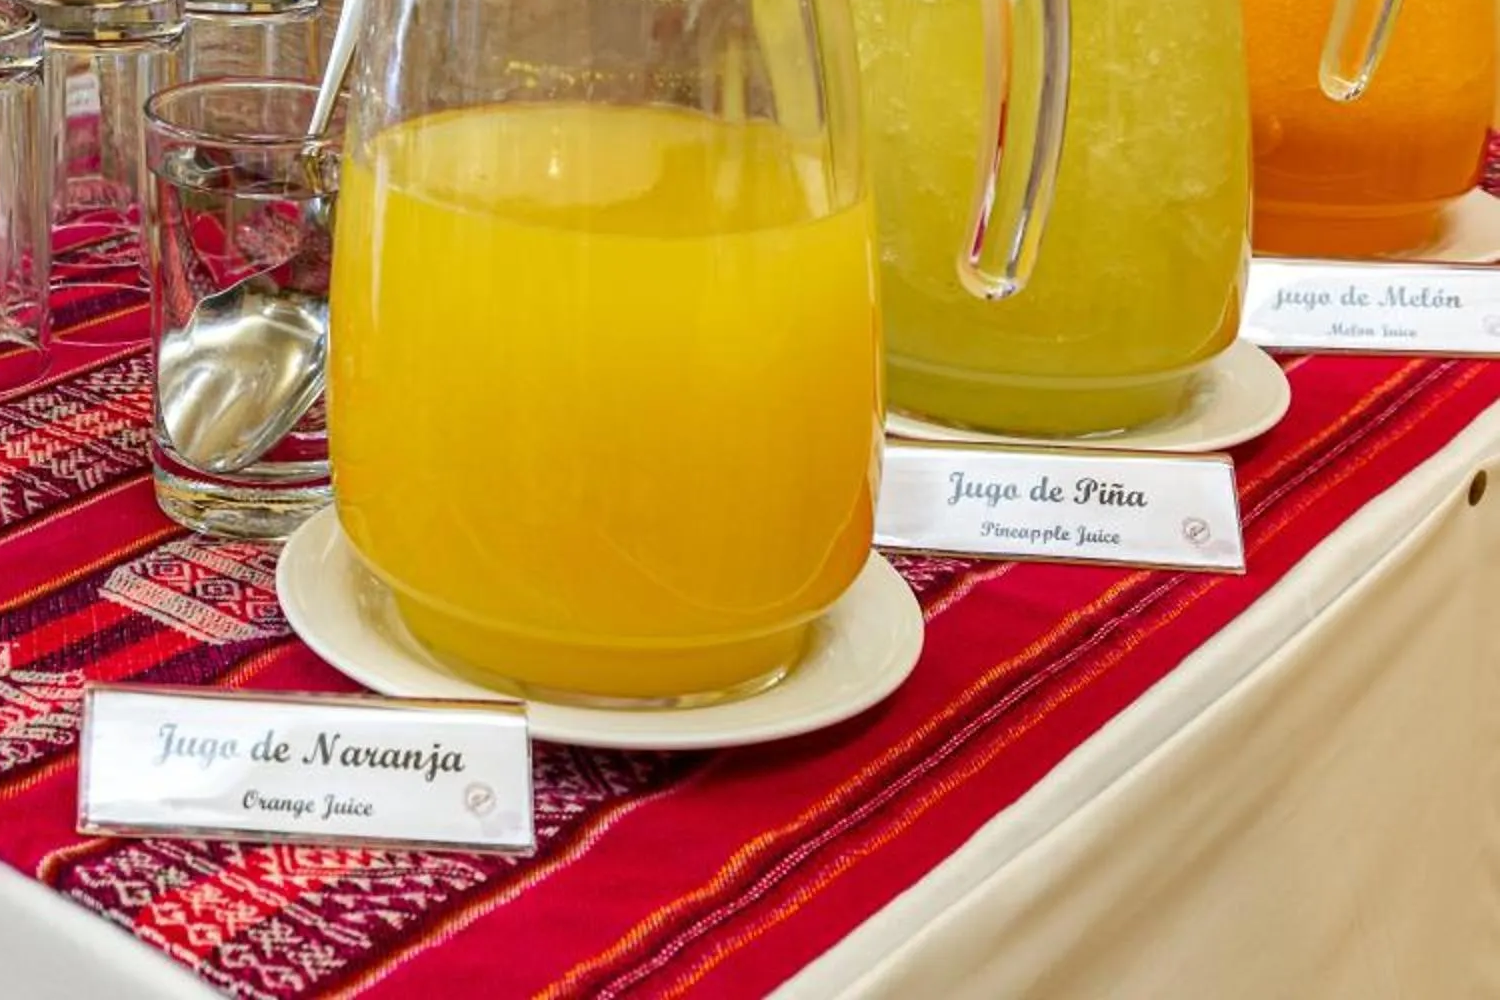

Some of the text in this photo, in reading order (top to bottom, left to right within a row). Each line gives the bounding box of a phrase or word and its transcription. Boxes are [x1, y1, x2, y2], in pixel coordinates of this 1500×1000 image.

[1340, 285, 1371, 307] de
[1378, 285, 1464, 309] Melón
[946, 471, 1148, 508] Jugo de Piña
[980, 521, 1121, 546] Pineapple Juice
[153, 722, 466, 783] Jugo de Naranja
[242, 790, 374, 819] Orange Juice
